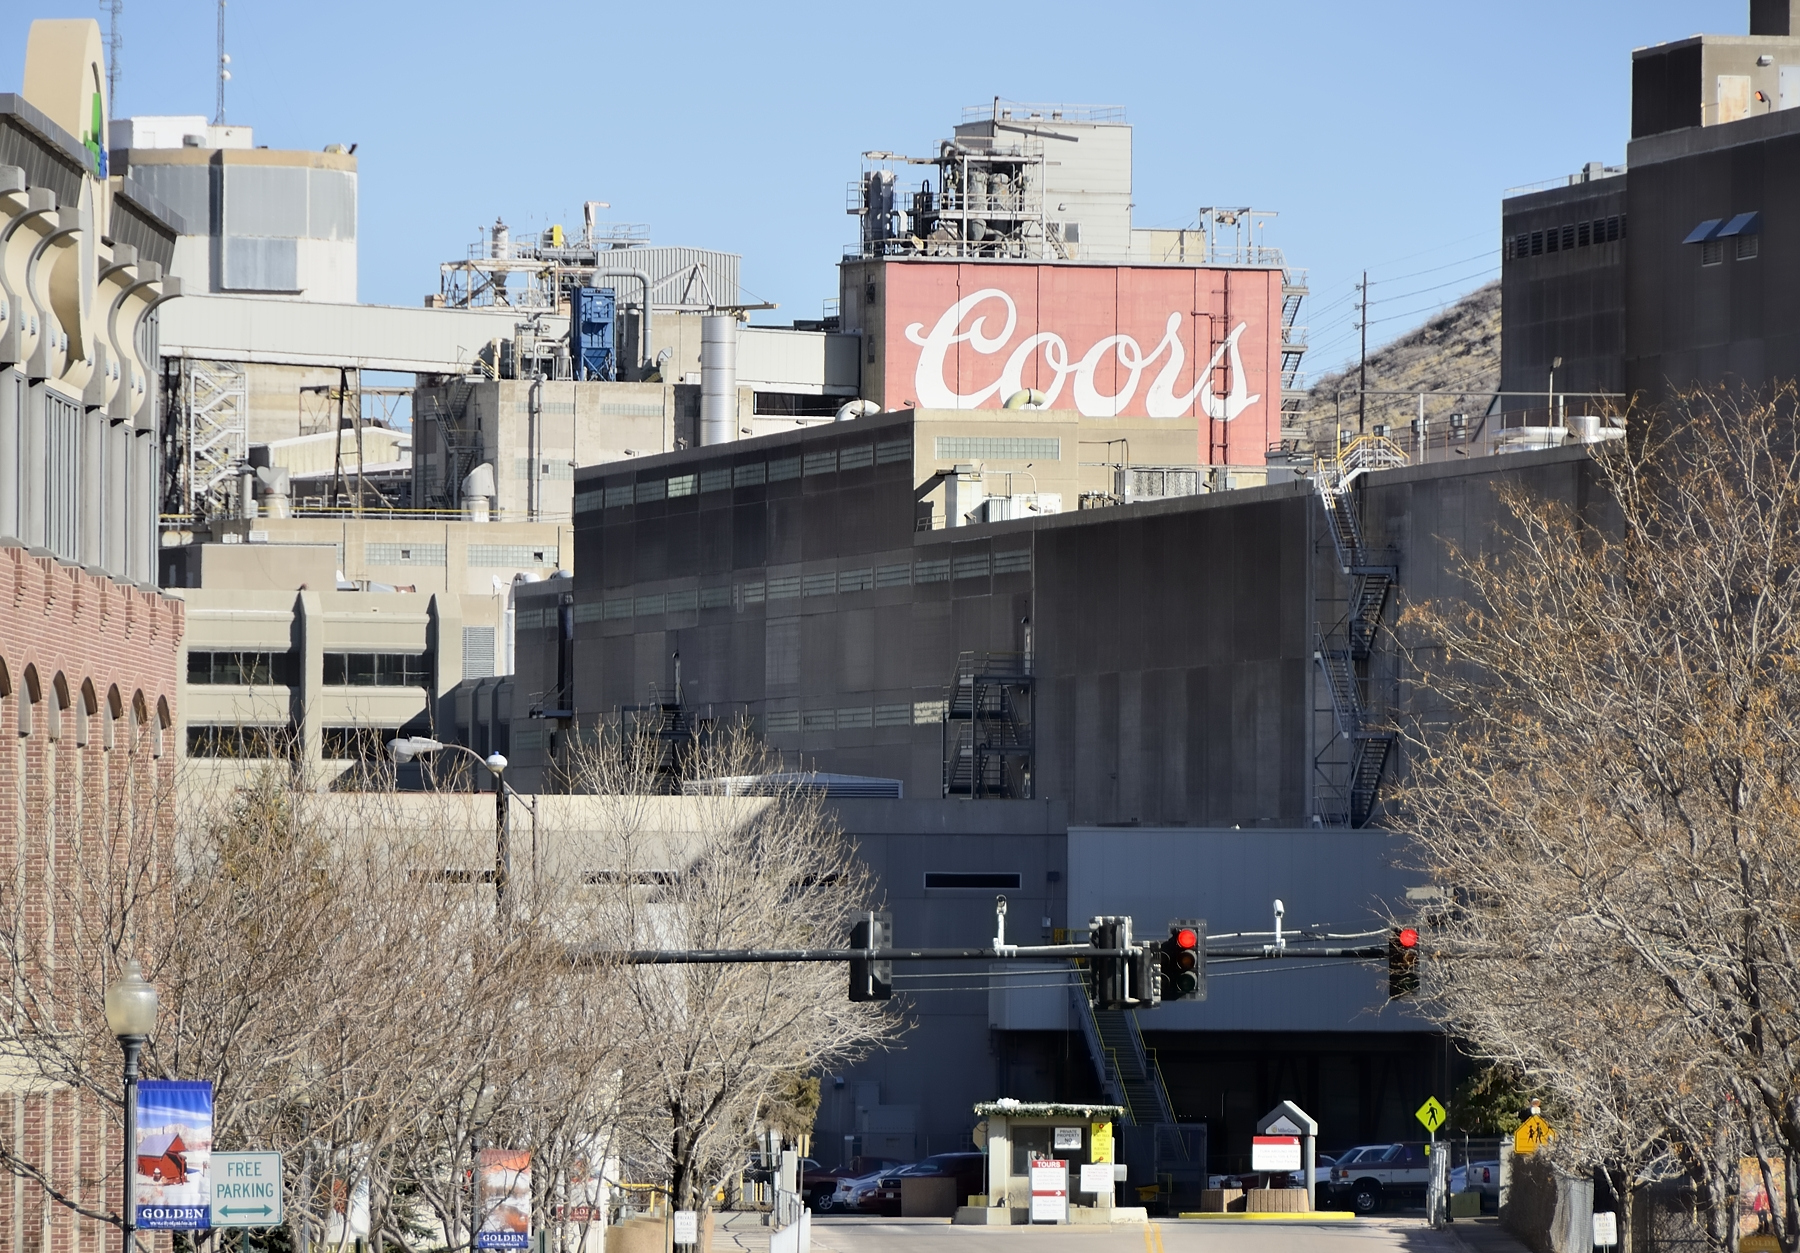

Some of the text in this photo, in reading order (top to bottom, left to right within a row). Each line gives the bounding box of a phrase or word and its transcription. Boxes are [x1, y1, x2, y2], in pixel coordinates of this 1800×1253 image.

[905, 288, 1261, 422] Coors
[227, 1161, 262, 1177] FREE
[216, 1182, 274, 1198] PARKING
[142, 1208, 205, 1219] GOLDEN
[482, 1233, 524, 1241] GOLDEN
